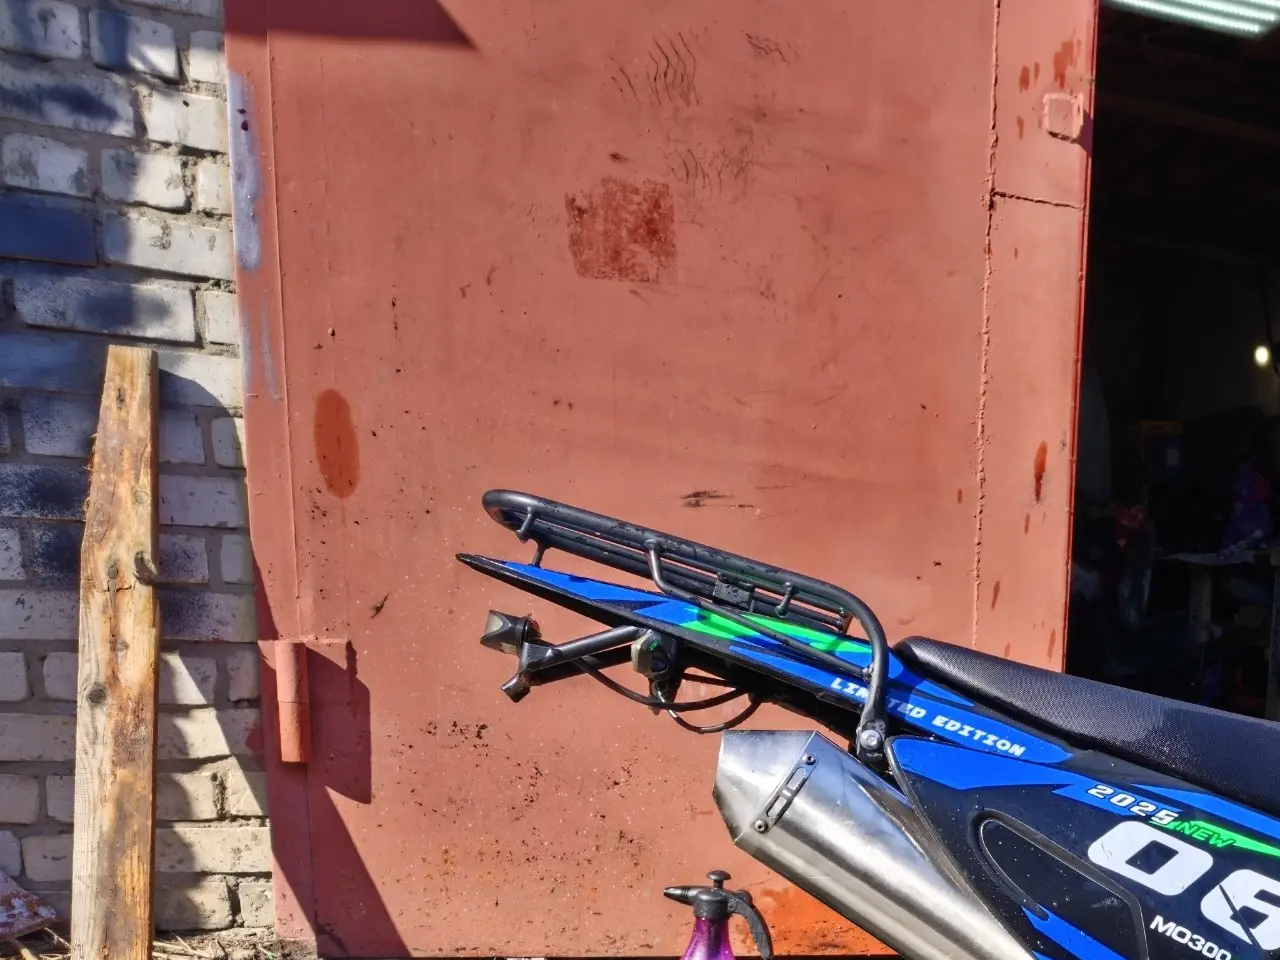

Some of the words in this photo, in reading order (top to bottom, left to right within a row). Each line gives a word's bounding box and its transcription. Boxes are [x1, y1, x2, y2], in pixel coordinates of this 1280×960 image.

[830, 677, 927, 718] LIMTED
[931, 713, 1027, 758] EDITION
[1087, 784, 1179, 826] 2025
[1175, 821, 1234, 847] NEW
